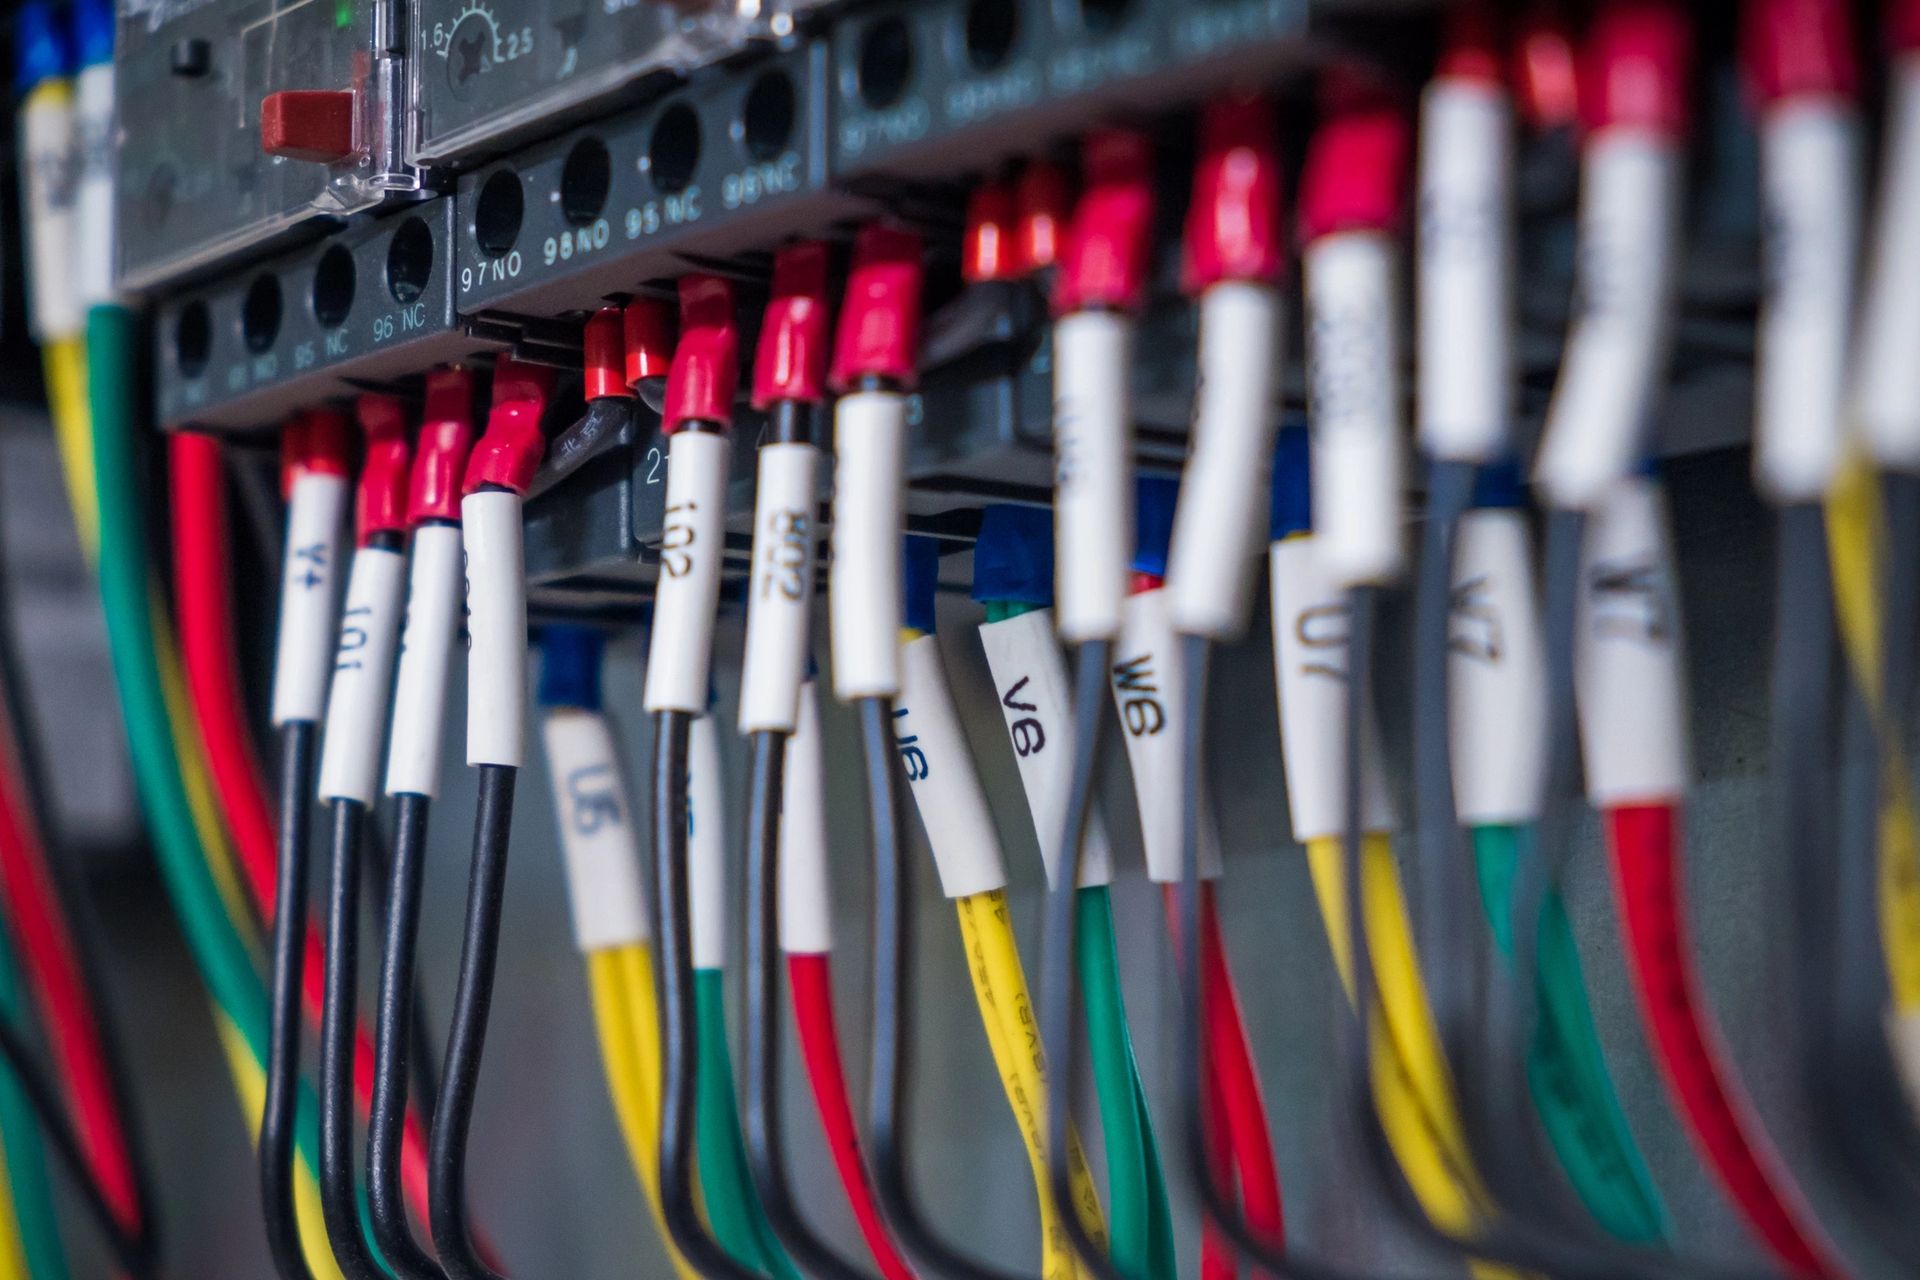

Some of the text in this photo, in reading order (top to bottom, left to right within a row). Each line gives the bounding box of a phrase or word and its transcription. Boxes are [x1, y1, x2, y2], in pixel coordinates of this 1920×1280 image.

[421, 22, 443, 50] 1.6
[373, 318, 395, 343] 96
[403, 302, 426, 332] NC
[1002, 675, 1046, 758] V6
[1112, 654, 1165, 738] W6
